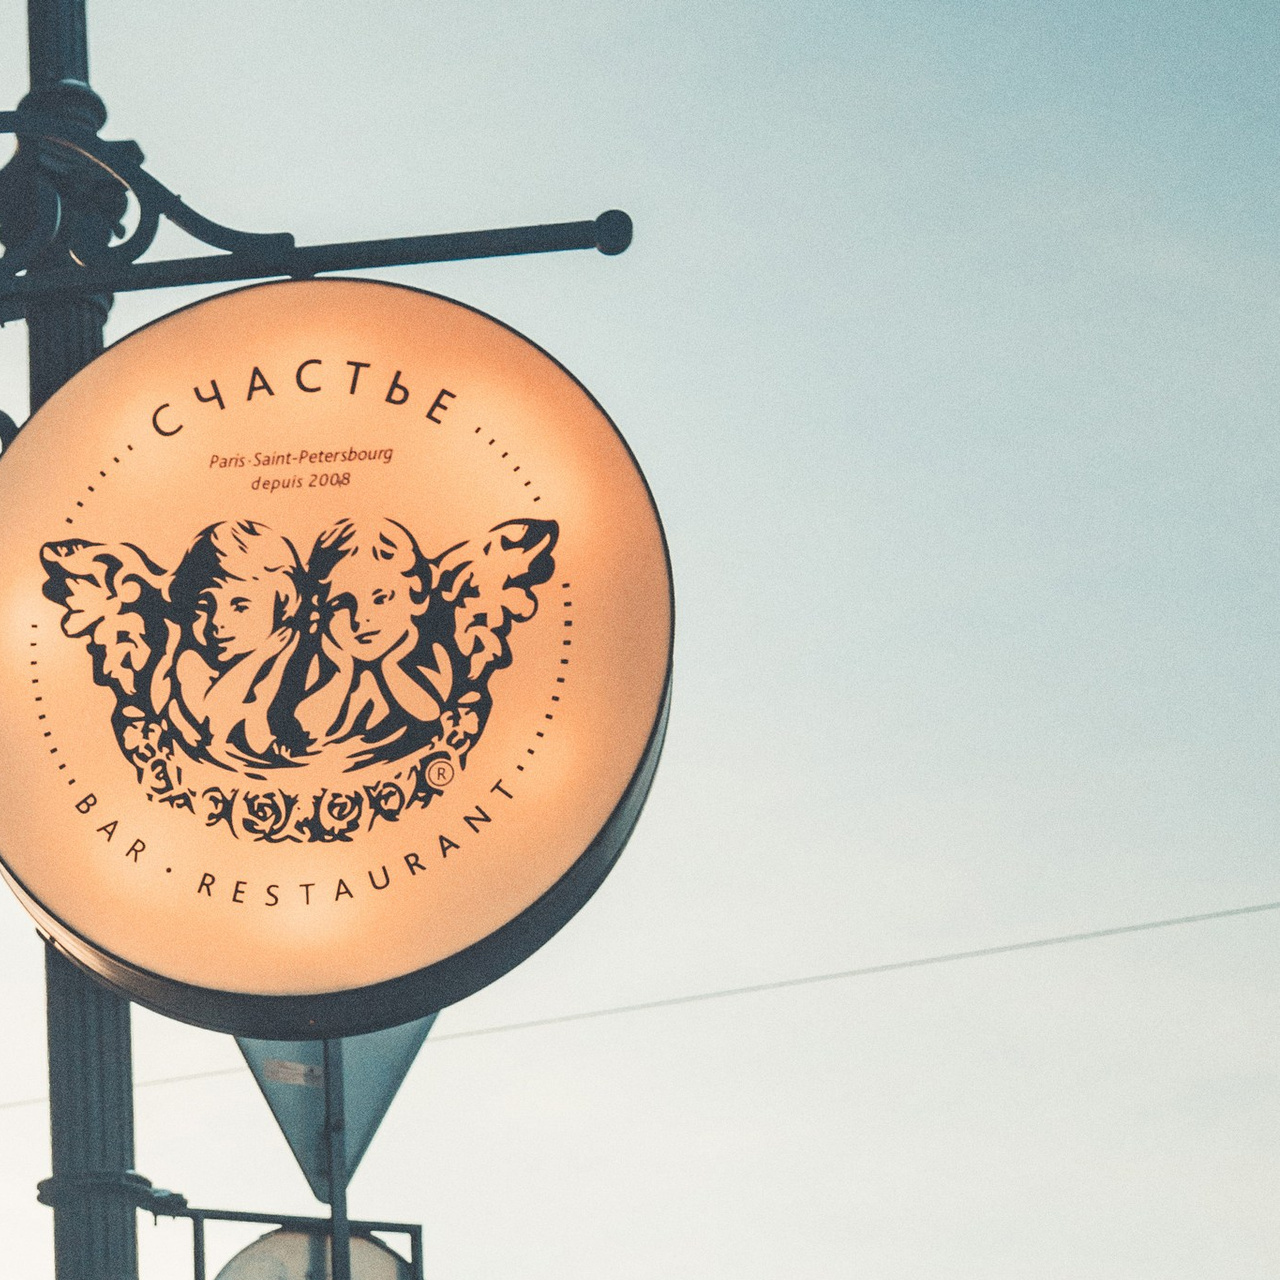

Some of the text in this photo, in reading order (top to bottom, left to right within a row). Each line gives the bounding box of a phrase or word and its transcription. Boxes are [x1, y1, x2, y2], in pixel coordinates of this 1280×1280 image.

[151, 358, 457, 437] СЧАСТЬЕ
[251, 472, 351, 493] depuis 2008
[74, 778, 514, 907] BAR RESTAURANT
